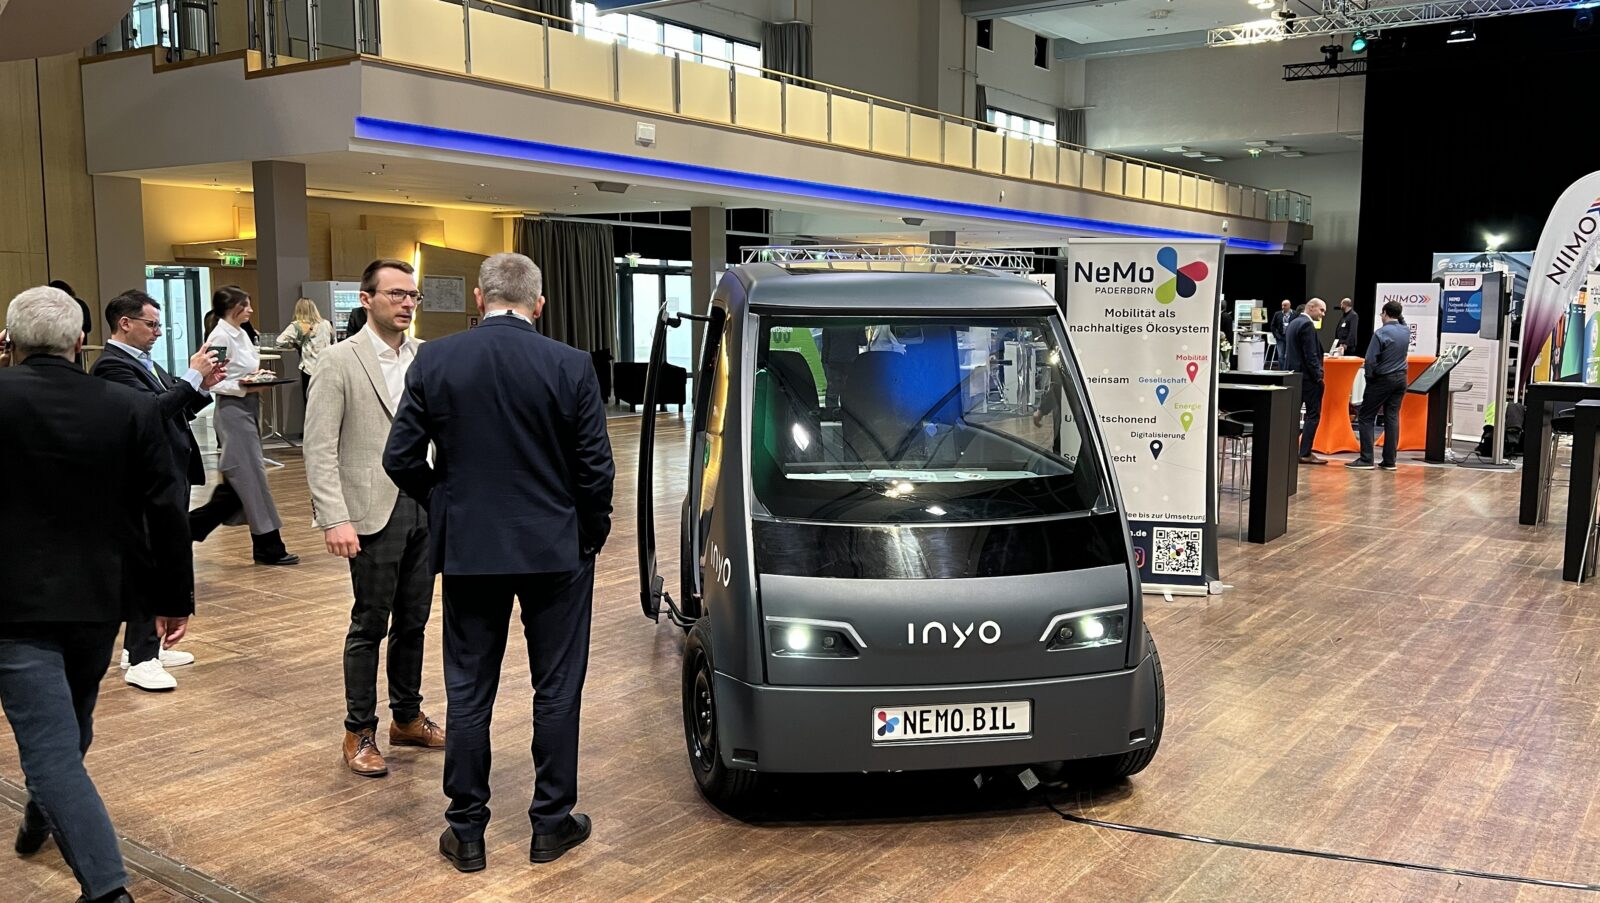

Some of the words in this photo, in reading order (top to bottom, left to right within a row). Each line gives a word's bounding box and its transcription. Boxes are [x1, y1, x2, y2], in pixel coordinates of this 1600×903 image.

[1545, 216, 1597, 286] NIIMO
[1074, 261, 1155, 283] NeMo
[1095, 286, 1154, 295] PADERBORN
[1383, 294, 1419, 304] NIIMO
[1104, 308, 1156, 318] Mobilität
[1158, 308, 1176, 318] als
[1069, 323, 1143, 335] nachhaltiges
[1145, 321, 1210, 335] Ökosystem
[1086, 376, 1130, 384] einsam
[1138, 376, 1187, 384] Gesellschaft
[1174, 403, 1202, 411] Energie
[1130, 431, 1186, 439] Digitalisierung
[903, 706, 1016, 735] NEMO.BIL
